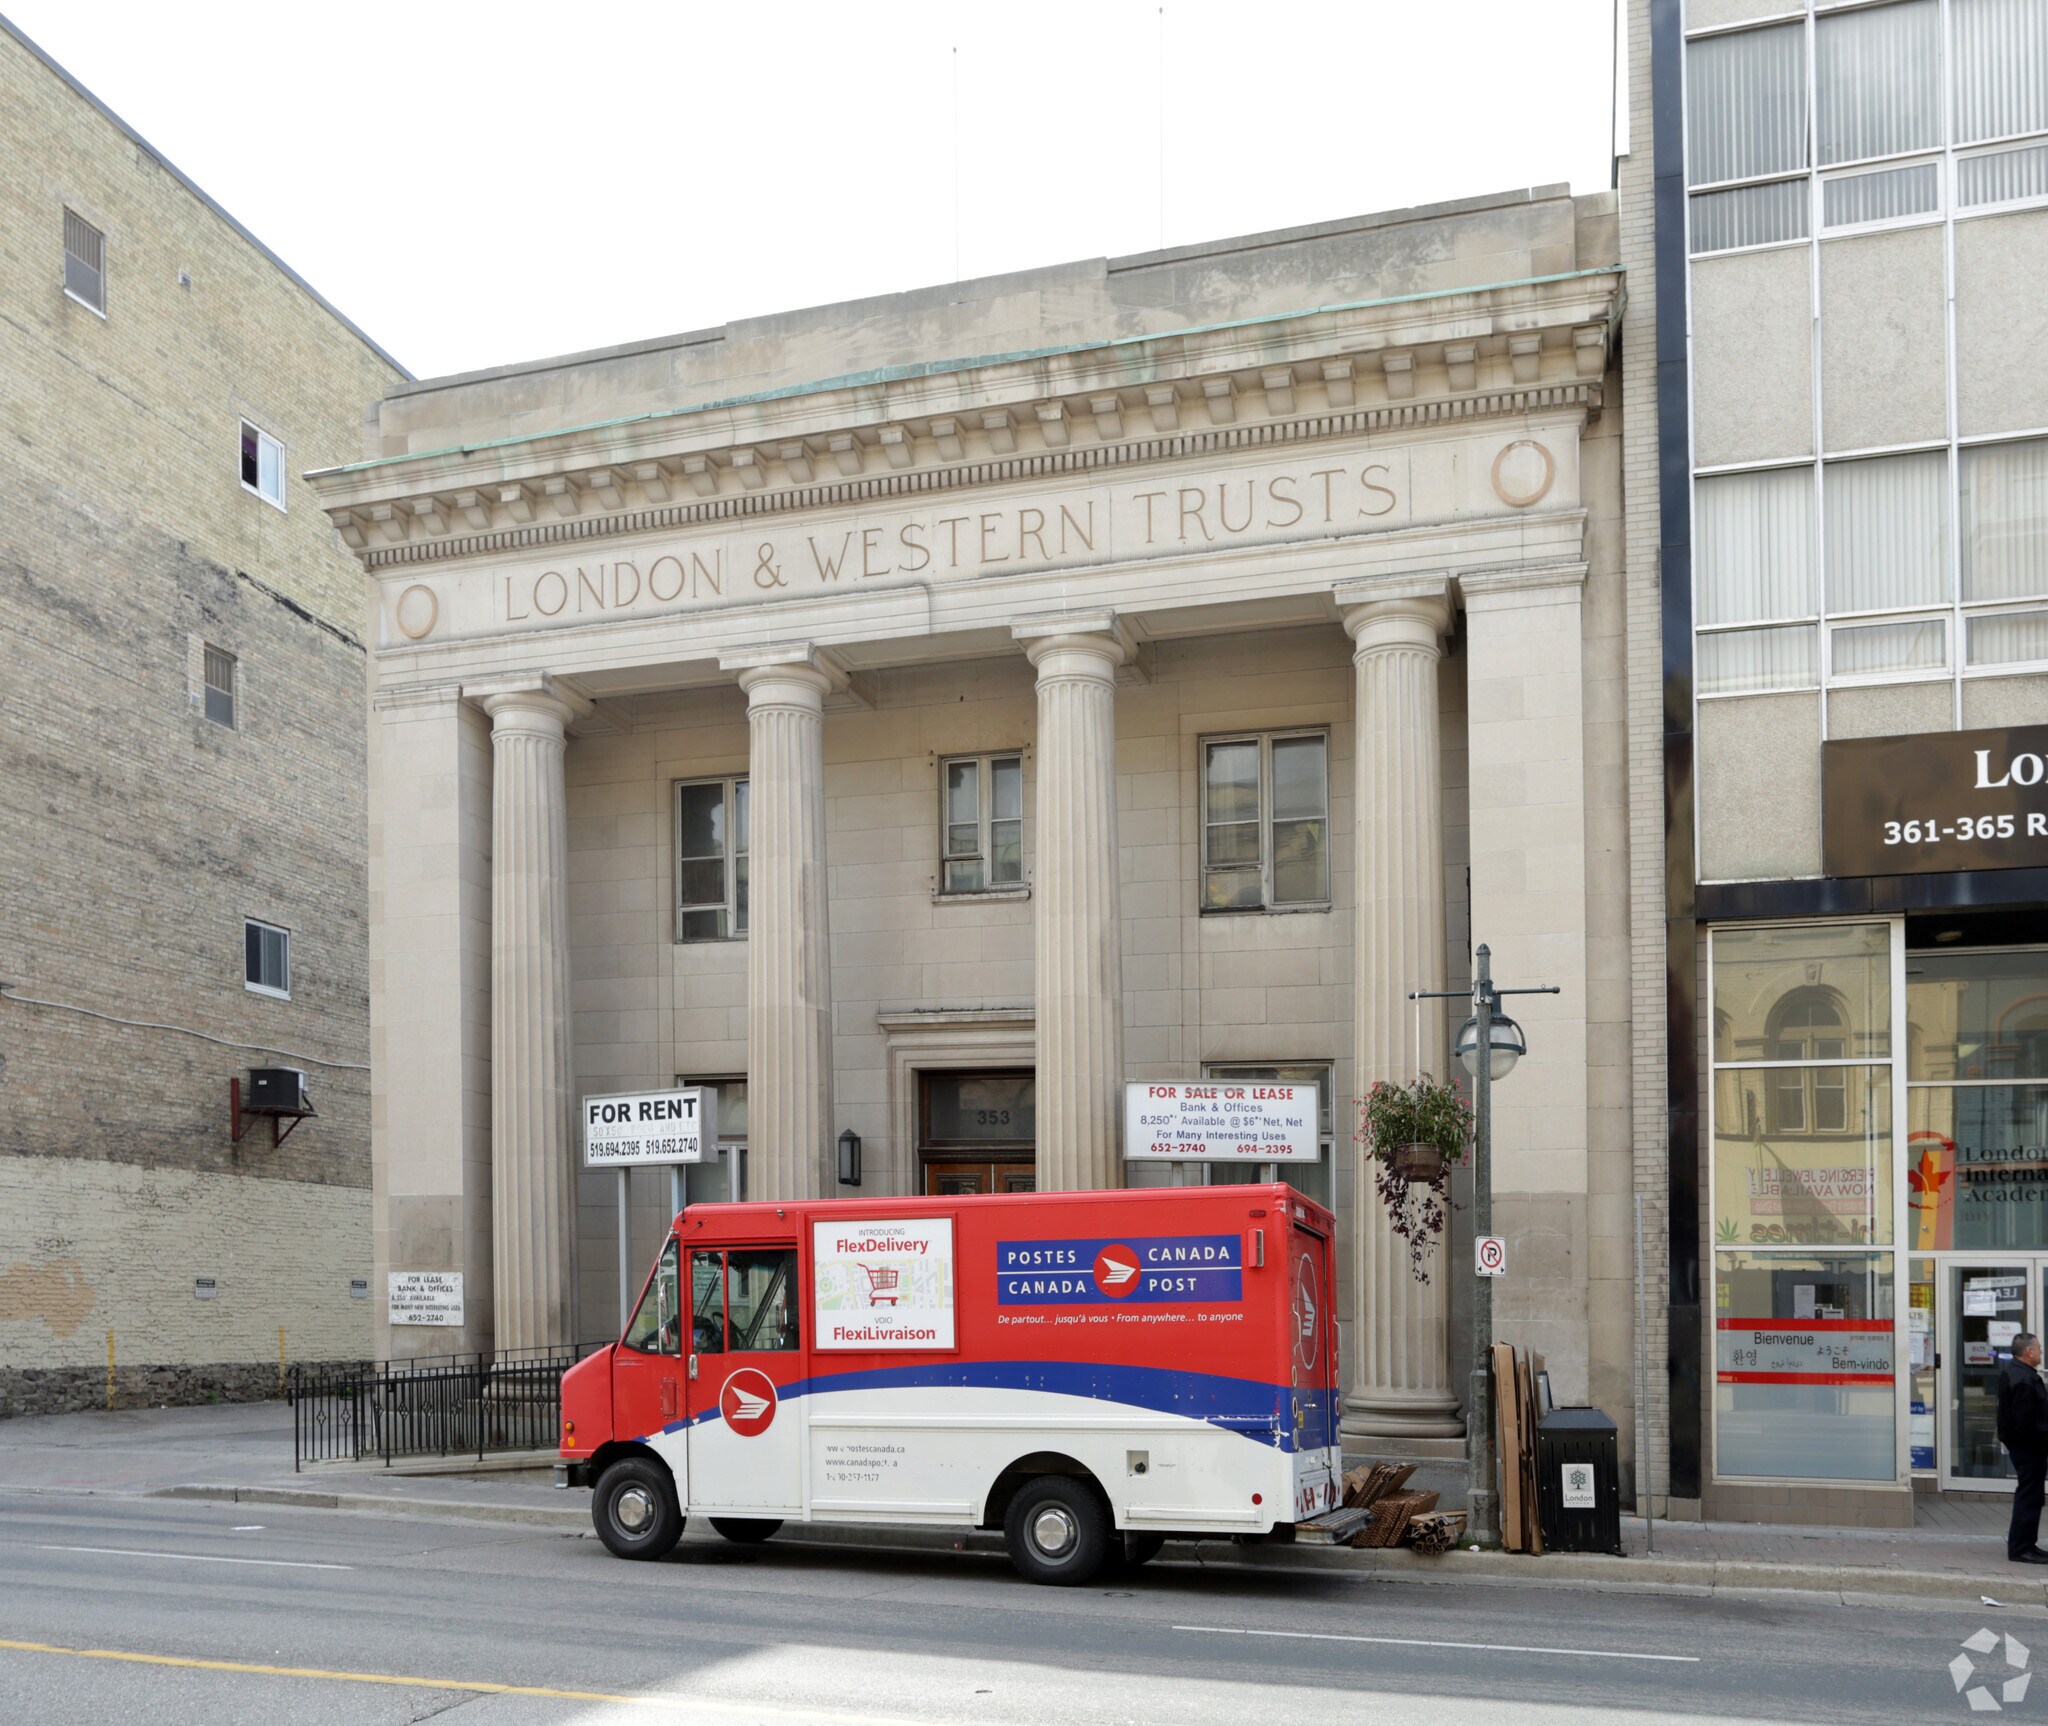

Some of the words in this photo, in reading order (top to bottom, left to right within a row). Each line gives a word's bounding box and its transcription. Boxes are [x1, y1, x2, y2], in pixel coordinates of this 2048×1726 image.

[506, 549, 722, 621] LONDON
[754, 542, 788, 588] &
[807, 501, 1094, 583] WESTERN
[1133, 465, 1397, 544] TRUSTS
[1974, 750, 2048, 789] Lo
[1883, 814, 2015, 845] 361-365
[1149, 1086, 1177, 1098] FOR
[1185, 1087, 1217, 1099] SALE
[1224, 1088, 1245, 1099] OR
[1252, 1088, 1293, 1100] LEASE
[590, 1103, 631, 1124] FOR
[639, 1098, 697, 1121] RENT
[1180, 1102, 1206, 1112] Bank
[1211, 1103, 1219, 1112] &
[1224, 1102, 1262, 1112] Offices
[977, 1110, 1010, 1125] 353
[1181, 1116, 1225, 1126] Available
[1230, 1116, 1241, 1128] @
[1263, 1117, 1283, 1128] Net,
[1285, 1118, 1303, 1127] Net
[1156, 1130, 1172, 1139] For
[1176, 1130, 1202, 1140] Many
[1206, 1130, 1258, 1142] Interesting
[1262, 1131, 1286, 1140] Uses
[591, 1140, 640, 1157] 519.694.2395
[646, 1137, 698, 1154] 519.652.2740
[1150, 1143, 1206, 1153] 652-2740
[1237, 1144, 1293, 1154] 694-2395
[858, 1228, 905, 1236] INTRODUCING
[836, 1238, 929, 1254] FlexDelivery
[1008, 1250, 1077, 1265] POSTES
[1148, 1246, 1230, 1262] CANADA
[428, 1285, 453, 1293] OFFICES
[1008, 1280, 1086, 1295] CANADA
[1149, 1277, 1197, 1292] POST
[408, 1314, 444, 1322] 652-2740
[998, 1315, 1010, 1324] De
[1088, 1315, 1108, 1323] vous
[1117, 1313, 1139, 1322] From
[1197, 1313, 1207, 1321] to
[1209, 1313, 1243, 1323] anyone
[833, 1326, 936, 1340] FlexiLivraison
[1754, 1332, 1814, 1345] Bienvenue
[1732, 1349, 1757, 1366] 환영
[1817, 1345, 1849, 1356] ようこそ
[1832, 1356, 1889, 1370] Bem-vindo
